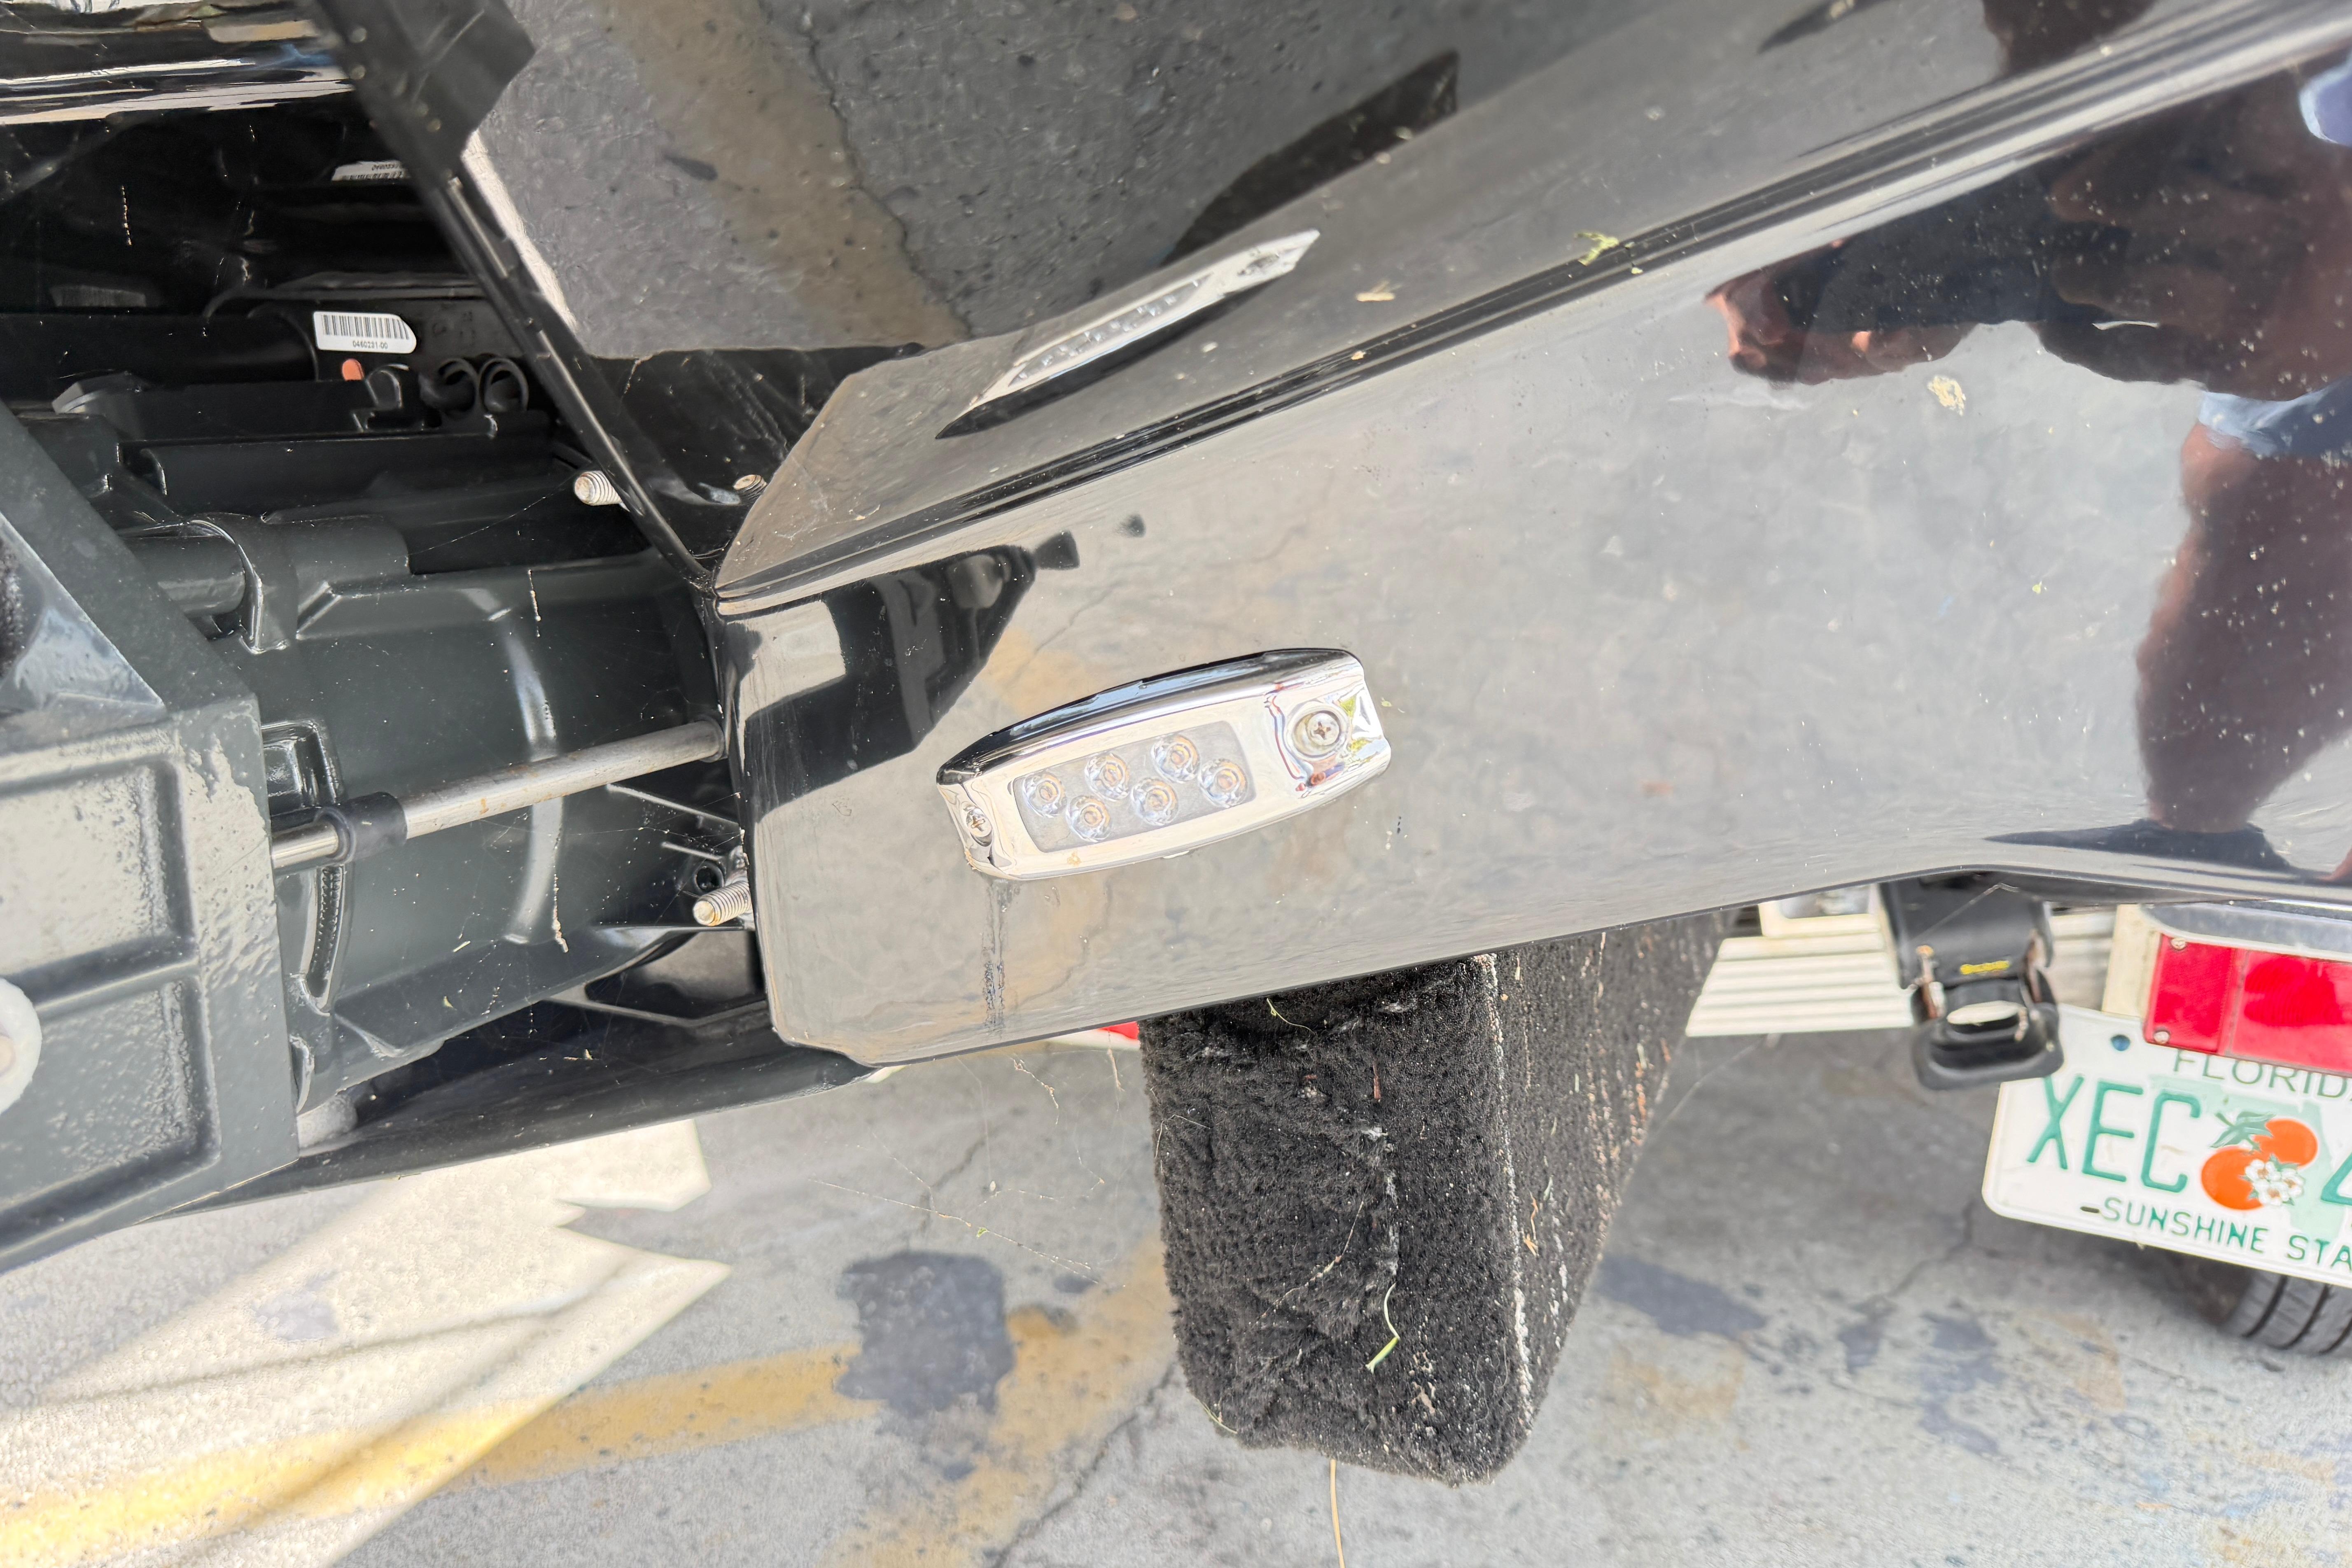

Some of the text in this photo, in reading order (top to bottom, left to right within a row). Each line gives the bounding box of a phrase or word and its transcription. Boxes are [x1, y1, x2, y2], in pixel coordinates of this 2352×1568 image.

[2173, 1048, 2352, 1101] FLORID
[2026, 1073, 2201, 1193] XEC
[2102, 1197, 2269, 1253] SUNSHINE
